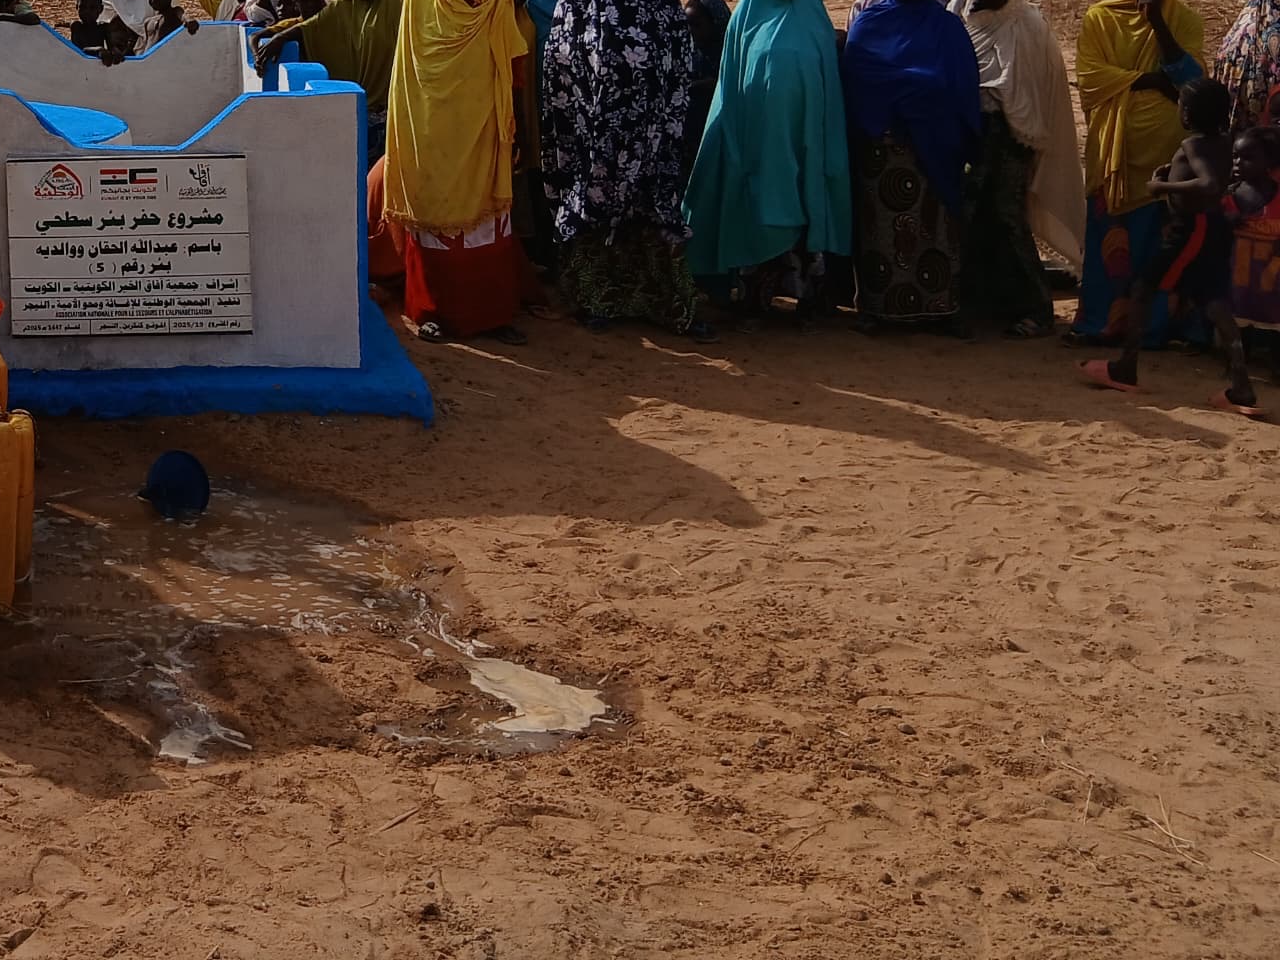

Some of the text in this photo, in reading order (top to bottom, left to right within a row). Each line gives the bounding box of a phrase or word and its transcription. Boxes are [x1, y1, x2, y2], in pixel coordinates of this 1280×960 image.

[35, 207, 223, 235] مشروع حفر بئر سطحي
[35, 242, 84, 259] ووالديه
[88, 240, 127, 258] الحقان
[130, 239, 177, 256] عبدالله
[121, 258, 144, 275] رقم
[148, 257, 171, 274] بئر
[24, 281, 60, 294] الكويت
[73, 280, 115, 294] الكويتية
[117, 280, 141, 293] الخير
[166, 279, 198, 292] جمعية
